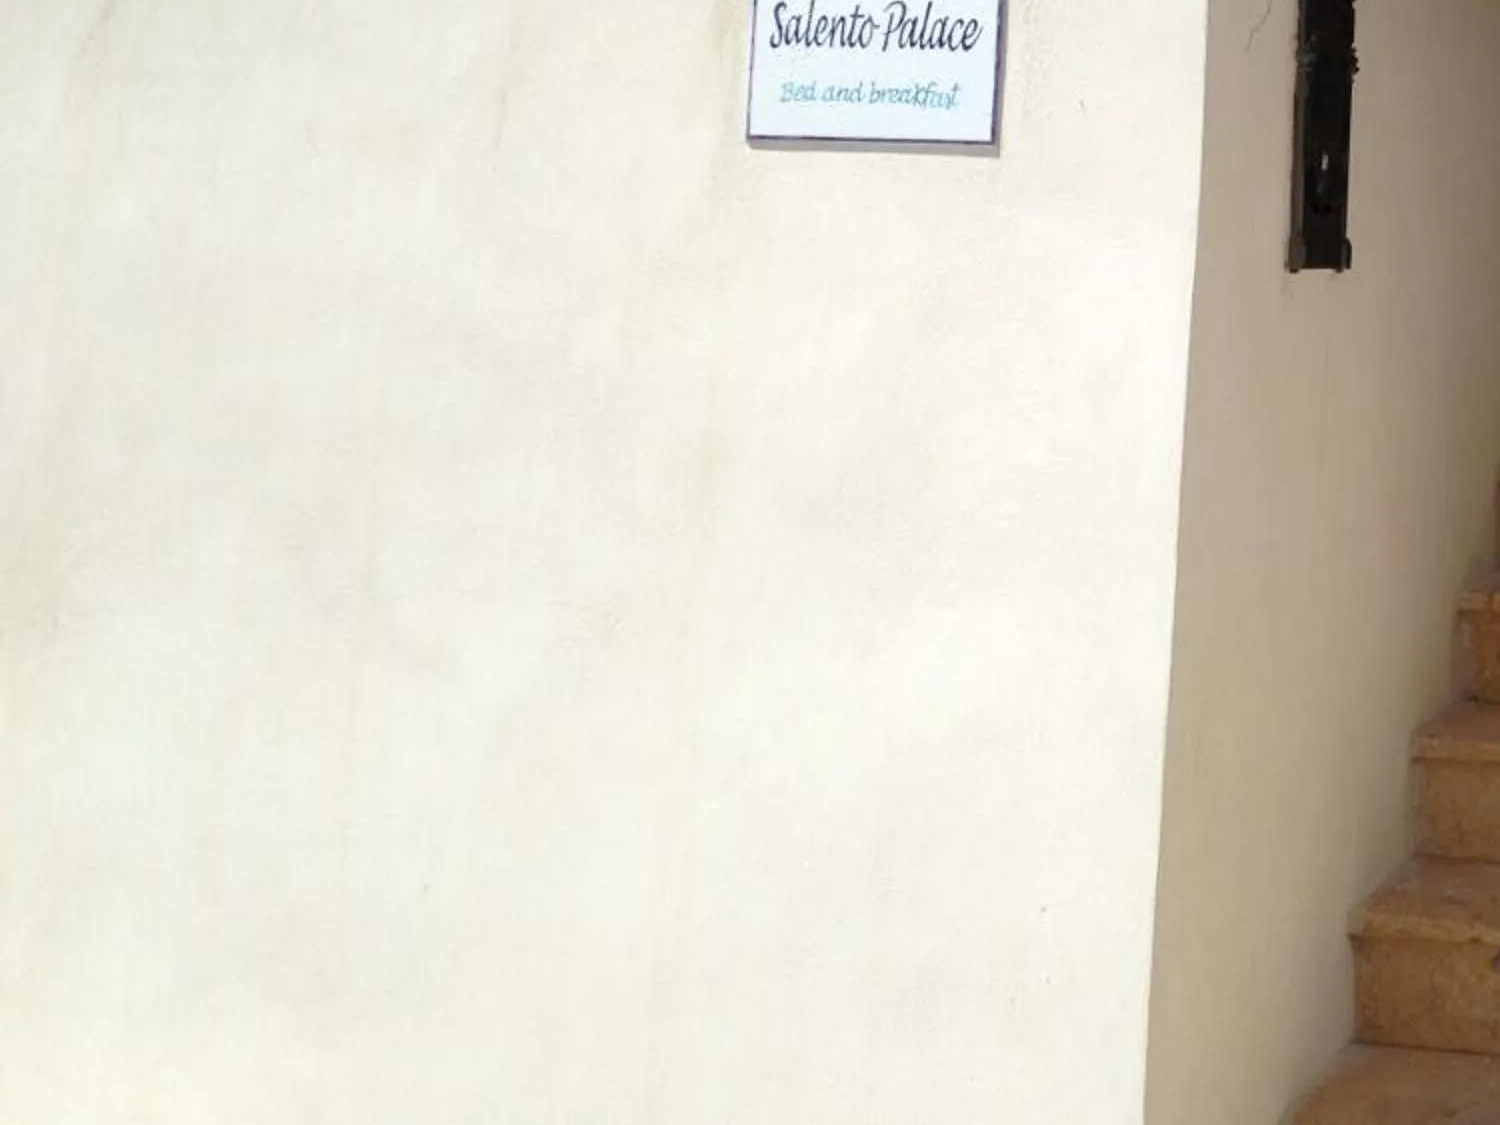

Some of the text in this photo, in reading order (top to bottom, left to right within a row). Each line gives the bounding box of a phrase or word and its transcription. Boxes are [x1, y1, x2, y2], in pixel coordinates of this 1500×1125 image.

[882, 0, 983, 52] Palace
[780, 81, 962, 109] Bed and breakfast
